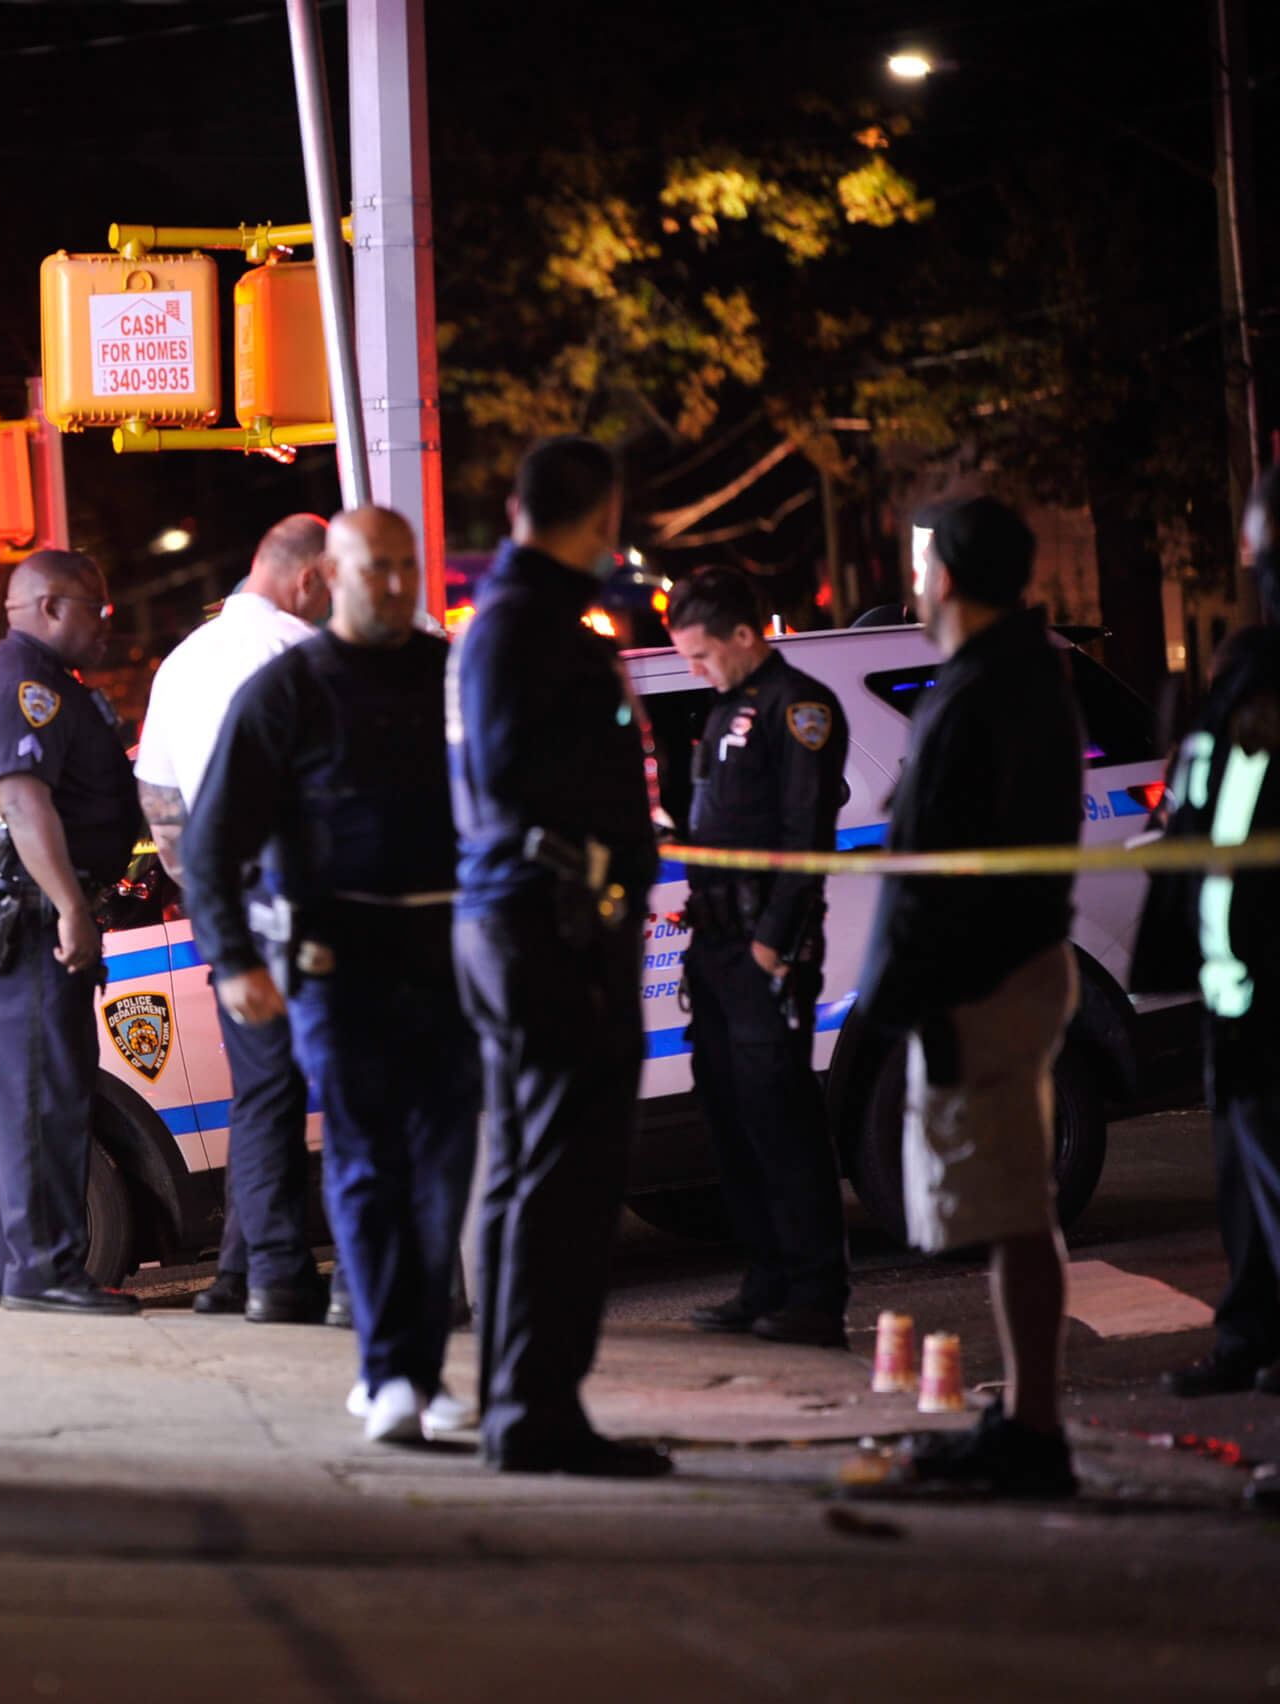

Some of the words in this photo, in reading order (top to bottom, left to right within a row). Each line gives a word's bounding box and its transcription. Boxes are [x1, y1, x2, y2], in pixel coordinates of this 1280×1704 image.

[120, 314, 167, 336] CASH
[101, 342, 131, 363] FOR
[135, 340, 188, 361] HOMES
[109, 367, 190, 392] 340-9935
[116, 996, 153, 1010] POLICE
[108, 1005, 167, 1027] DEPARTMENT
[115, 1036, 131, 1056] CITY
